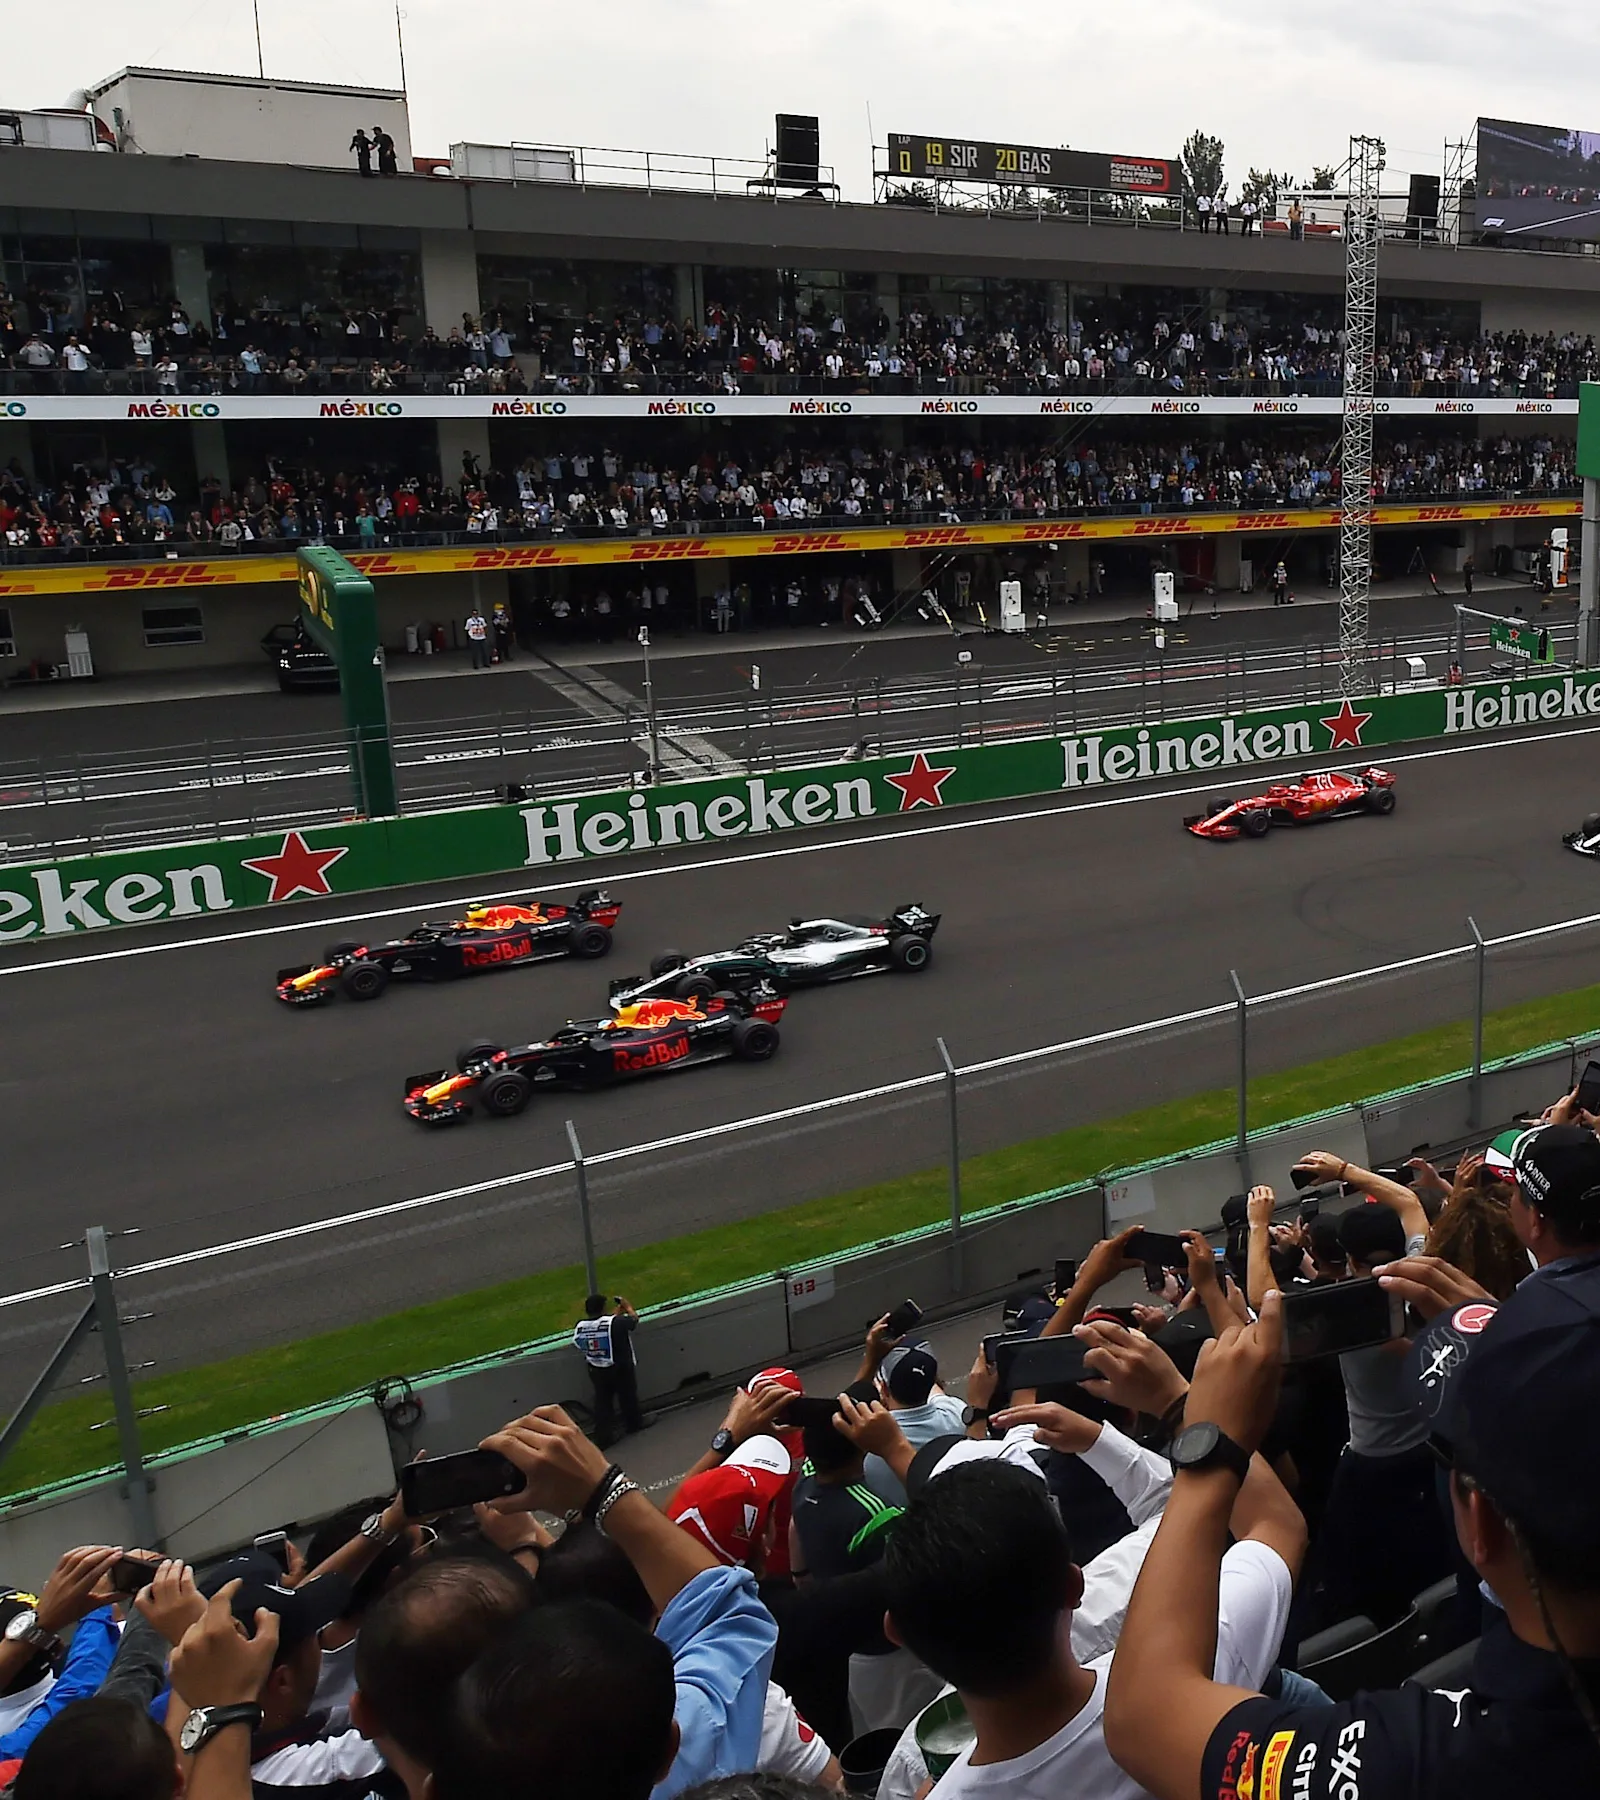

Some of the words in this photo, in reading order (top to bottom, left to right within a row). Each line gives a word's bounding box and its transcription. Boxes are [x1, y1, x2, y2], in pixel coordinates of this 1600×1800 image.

[925, 143, 943, 165] 19
[950, 145, 978, 168] SIR
[996, 149, 1017, 171] 20
[1019, 152, 1050, 174] GAS
[1418, 507, 1463, 520] DHL
[1500, 503, 1540, 516] DHL
[1134, 519, 1191, 534] DHL
[1236, 513, 1290, 528] DHL
[904, 528, 972, 545] DHL
[1024, 523, 1088, 539] DHL
[630, 540, 710, 560] DHL
[772, 534, 846, 552] DHL
[473, 548, 562, 568] DHL
[104, 565, 216, 588] DHL
[1496, 640, 1531, 659] Heineken
[1061, 720, 1314, 788] Heineken
[519, 778, 877, 866] Heineken
